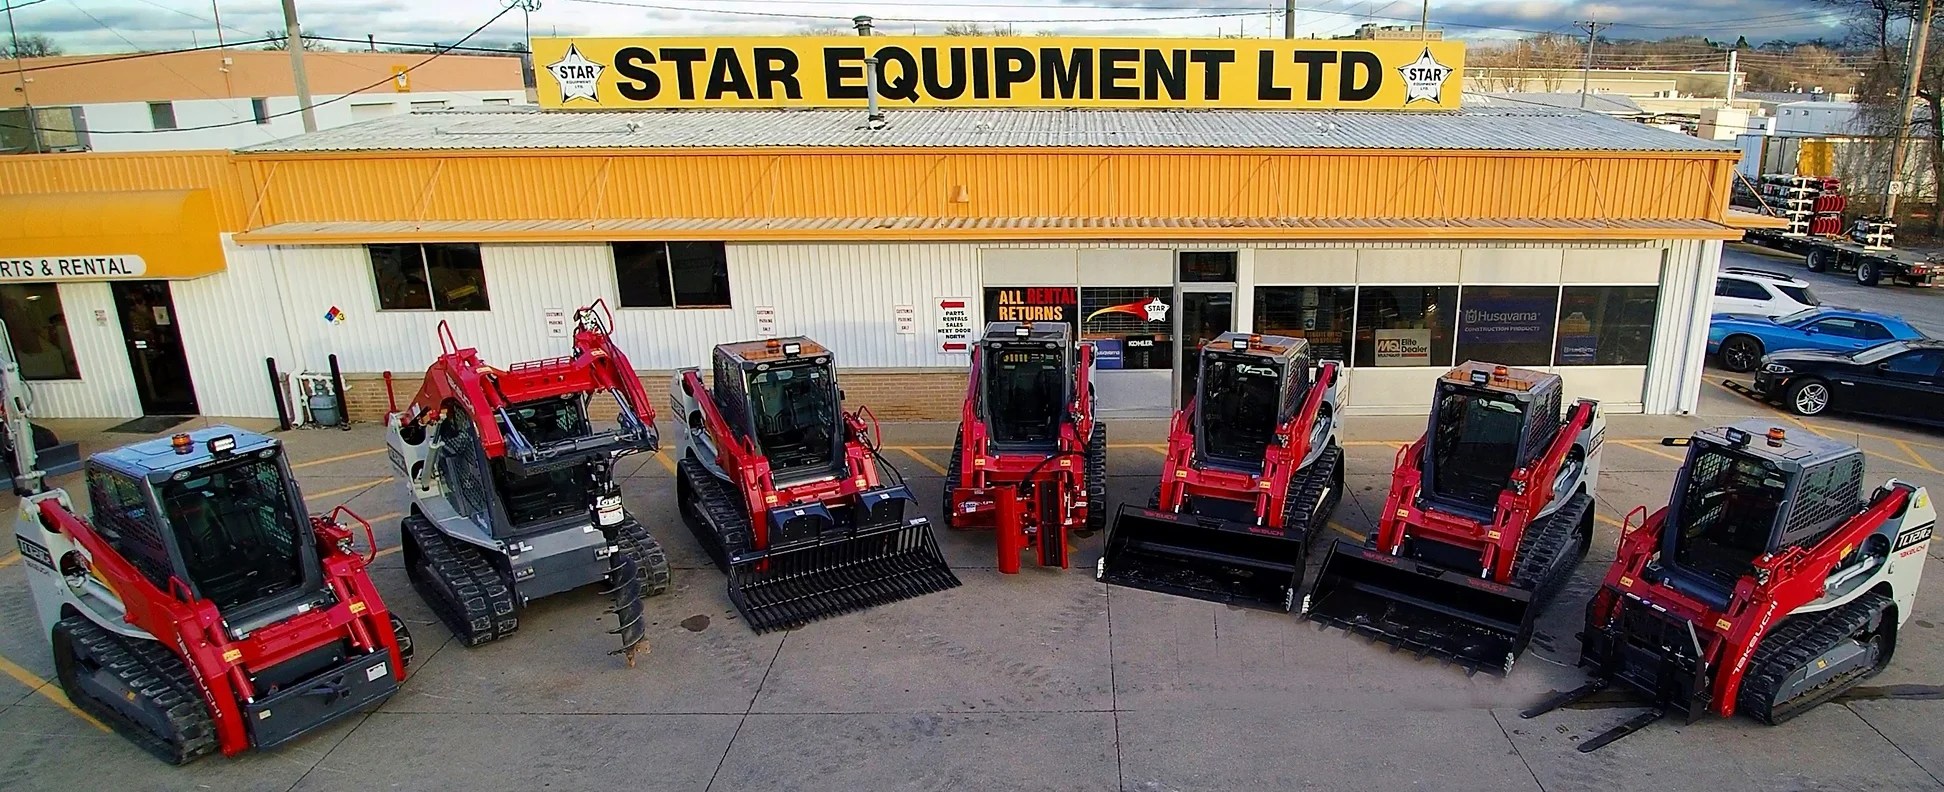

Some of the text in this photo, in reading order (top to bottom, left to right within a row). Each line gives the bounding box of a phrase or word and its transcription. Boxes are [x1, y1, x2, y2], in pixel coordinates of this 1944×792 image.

[560, 65, 595, 79] STAR
[614, 46, 1383, 103] STAR EQUIPMENT LTD
[1409, 68, 1441, 81] STAR
[0, 258, 132, 277] RTS & RENTAL
[999, 288, 1077, 305] ALL RENTAL
[999, 306, 1063, 321] RETURNS
[1478, 311, 1537, 324] Husqvarna
[1402, 338, 1417, 346] Elite
[1732, 600, 1778, 675] TAKEUCHI
[176, 632, 222, 718] TAKEUCHI
